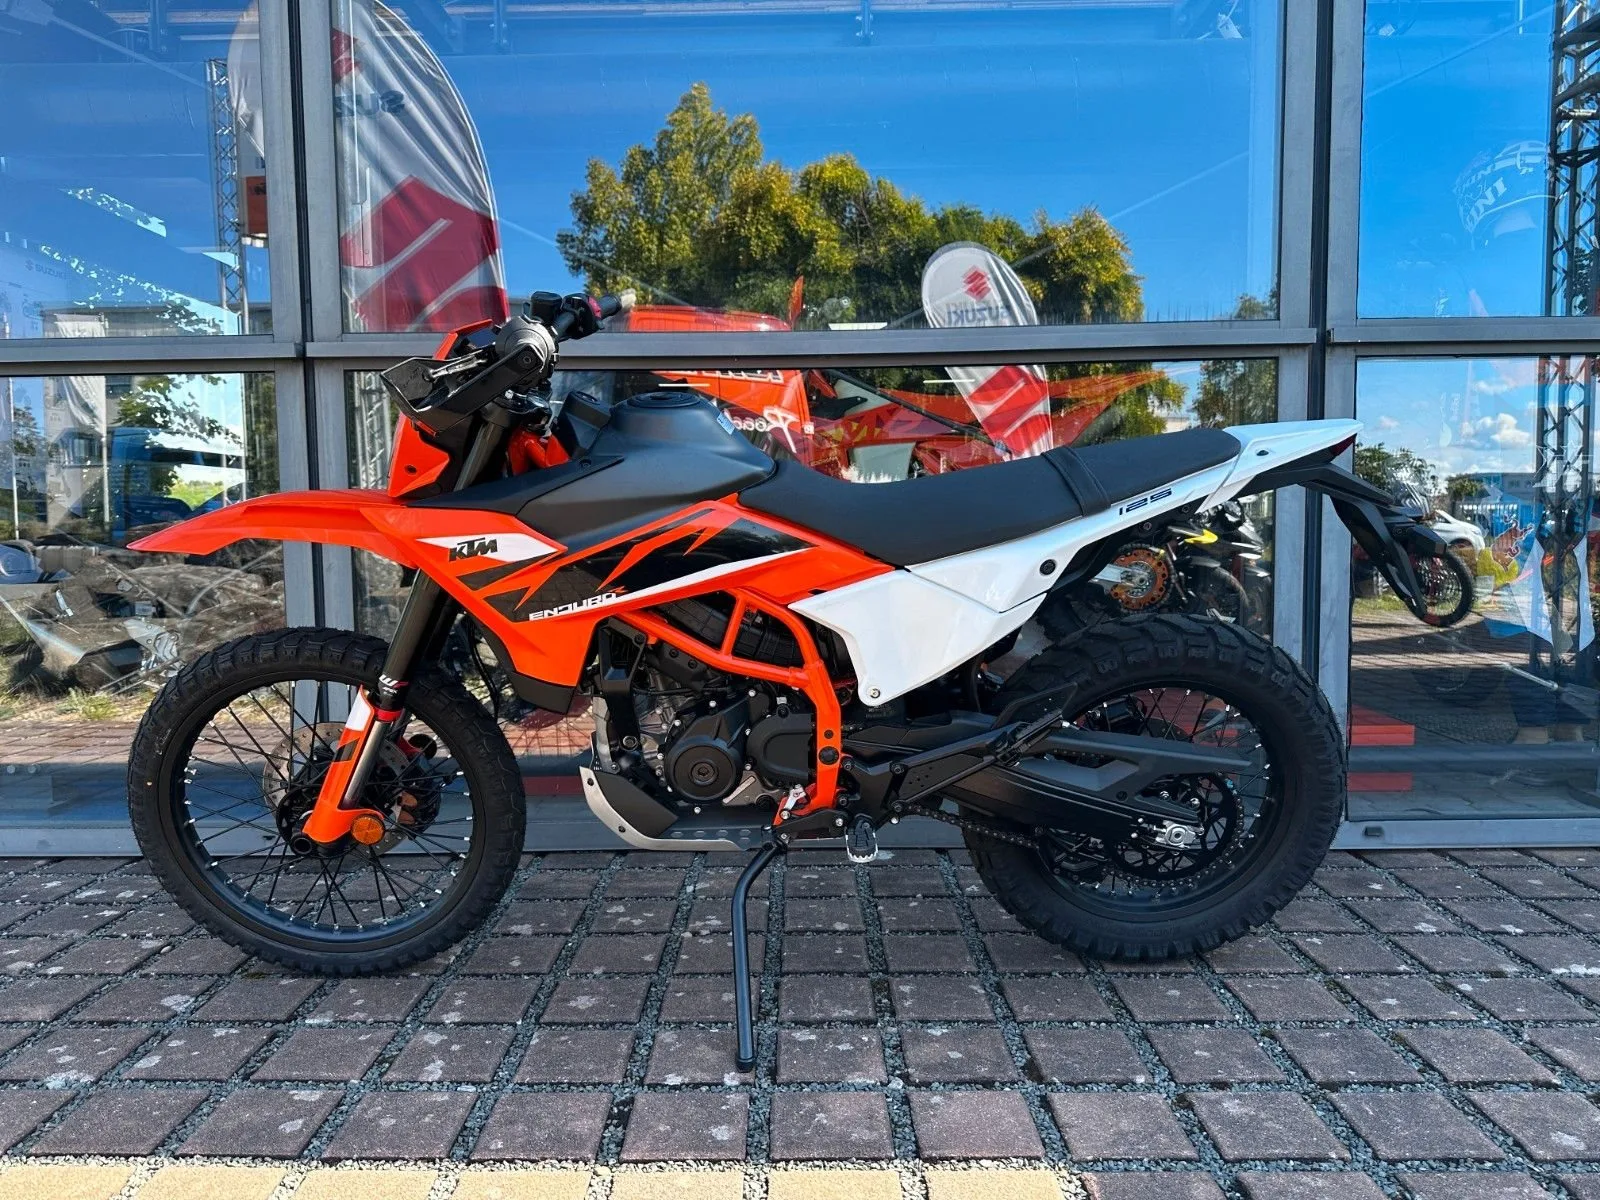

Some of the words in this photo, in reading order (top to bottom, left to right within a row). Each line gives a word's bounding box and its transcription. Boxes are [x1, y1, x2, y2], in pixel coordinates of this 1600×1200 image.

[1119, 488, 1172, 515] 125
[449, 537, 498, 562] KTM
[529, 592, 617, 621] ENDURO
